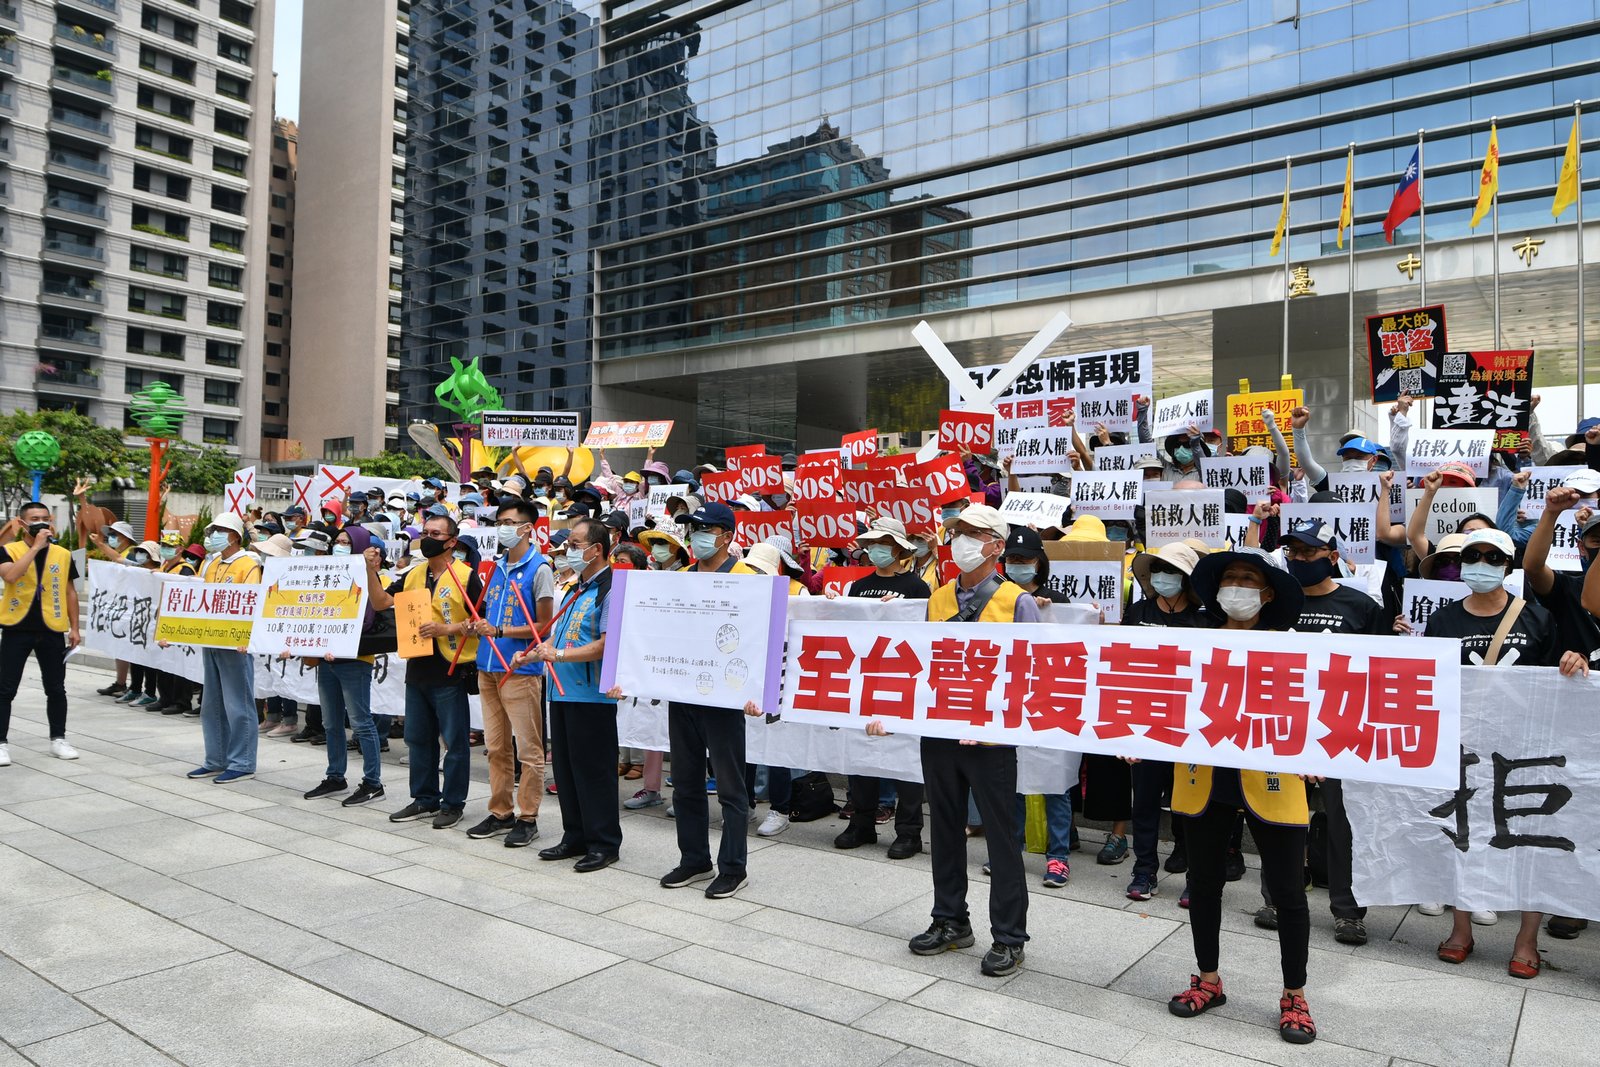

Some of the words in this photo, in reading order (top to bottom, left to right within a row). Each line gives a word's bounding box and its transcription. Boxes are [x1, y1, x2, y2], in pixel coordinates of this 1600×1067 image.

[1289, 236, 1545, 299] 臺中市
[1381, 312, 1430, 332] 最大的
[1392, 352, 1426, 370] 集團
[1493, 355, 1529, 368] 執行署
[1081, 400, 1128, 418] 搶救人權
[1158, 399, 1209, 423] 搶救人權
[1233, 398, 1297, 418] 執行利刃
[1434, 382, 1529, 428] 違法
[940, 421, 992, 445] SOS
[1016, 437, 1068, 457] 搶救人權
[1412, 439, 1487, 458] 搶救人權
[742, 465, 781, 488] SOS
[793, 475, 834, 501] SOS
[1206, 467, 1265, 488] 搶救人權
[1075, 481, 1138, 501] 搶救人權
[876, 497, 933, 525] SOS
[1150, 503, 1220, 527] 搶救人權
[800, 513, 856, 539] SOS
[1151, 530, 1180, 538] Freedom
[1182, 530, 1191, 538] of
[1194, 529, 1220, 538] Belief
[167, 587, 259, 616] 停止人權迫害
[161, 623, 176, 636] Stop
[177, 624, 203, 638] Abusing
[204, 626, 228, 637] Human
[229, 627, 252, 641] Rights
[791, 635, 1440, 769] 全台聲援黃媽媽
[1428, 743, 1576, 853] 拒
